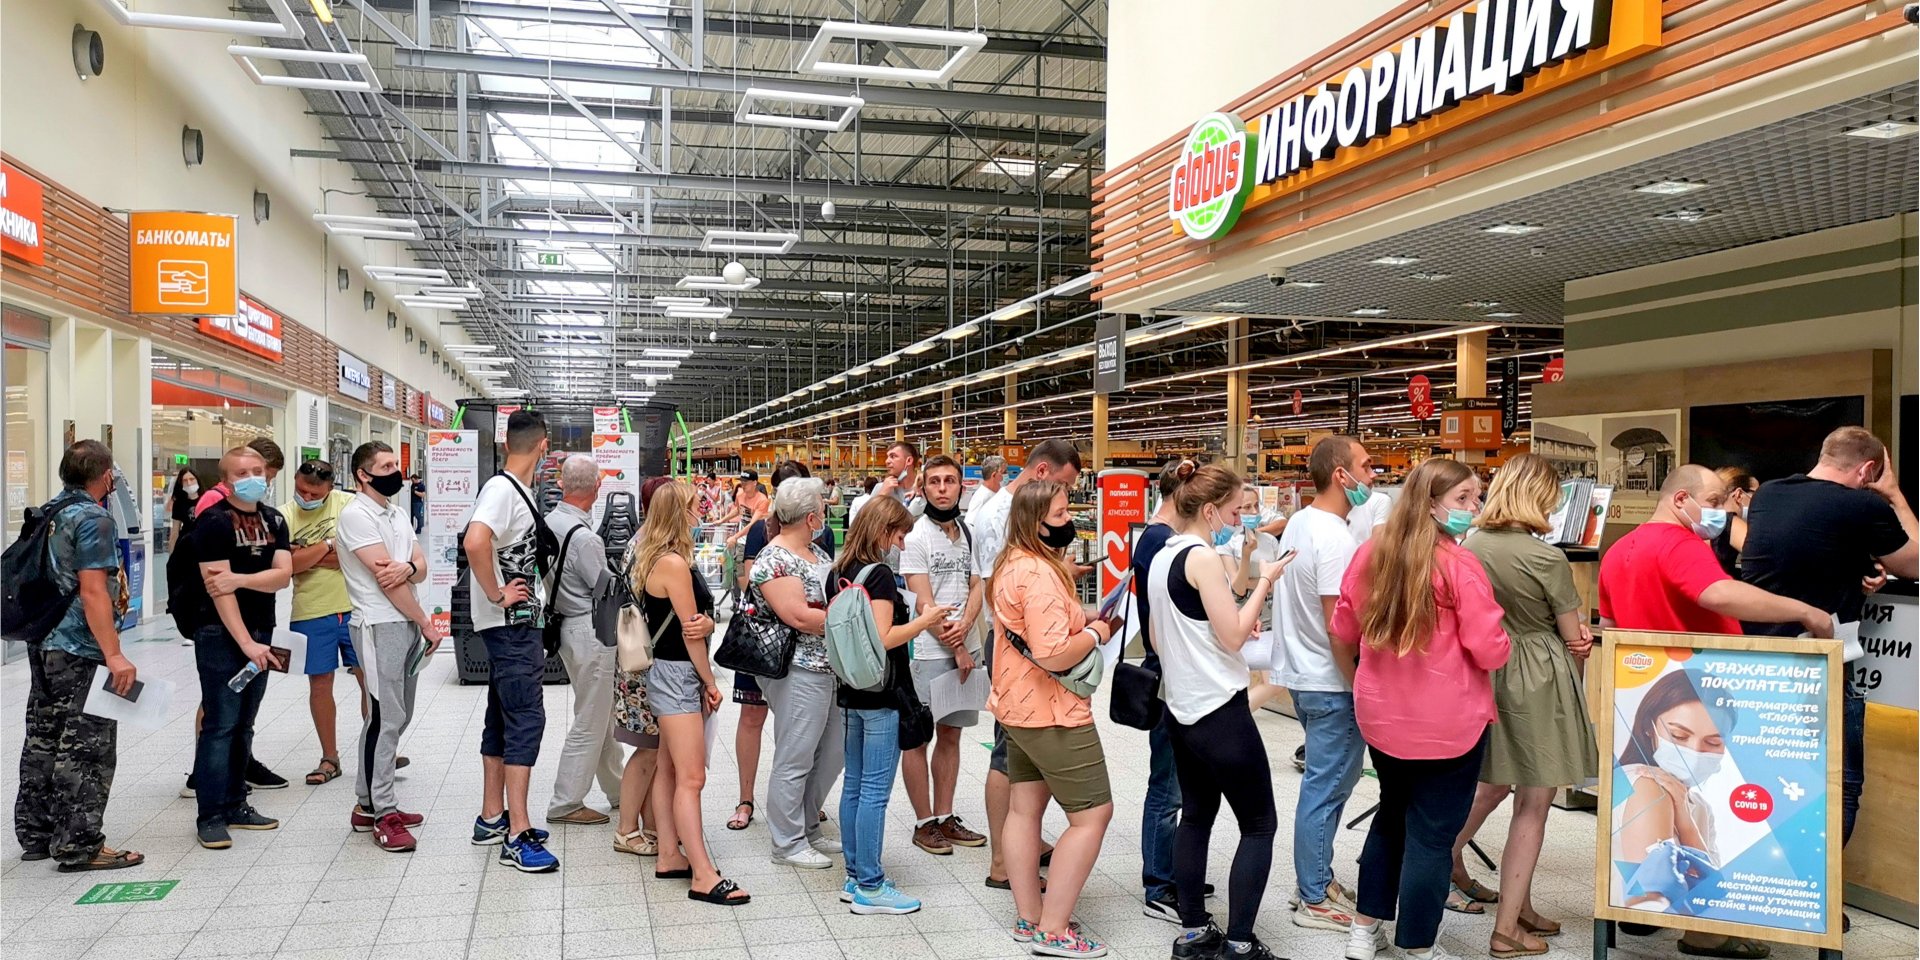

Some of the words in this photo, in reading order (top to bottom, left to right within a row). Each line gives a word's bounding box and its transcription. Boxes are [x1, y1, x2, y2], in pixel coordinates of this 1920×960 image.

[1256, 0, 1596, 184] ИНФОРМАЦИЯ
[136, 230, 230, 248] БАНКОМАТЫ
[1108, 509, 1140, 517] АТМОСФЕРУ
[1704, 661, 1821, 679] УВАЖАЕМЫЕ
[1856, 667, 1882, 690] 19
[1701, 676, 1821, 695] ПОКУПАТЕЛИ!
[1726, 699, 1819, 713] гипермаркете
[1759, 711, 1818, 724] «Глобус»
[1760, 725, 1820, 738] работает
[1732, 734, 1819, 749] прививочный
[1765, 749, 1819, 761] кабинет
[1735, 800, 1758, 809] COVID
[1759, 802, 1767, 810] 19
[1733, 872, 1808, 888] Информацию
[1810, 881, 1817, 889] о
[1716, 881, 1821, 899] местонахождении
[1692, 897, 1705, 906] на
[1708, 899, 1747, 911] стойке
[1748, 904, 1821, 920] информации
[1725, 891, 1765, 903] можно
[1766, 896, 1821, 910] уточнить
